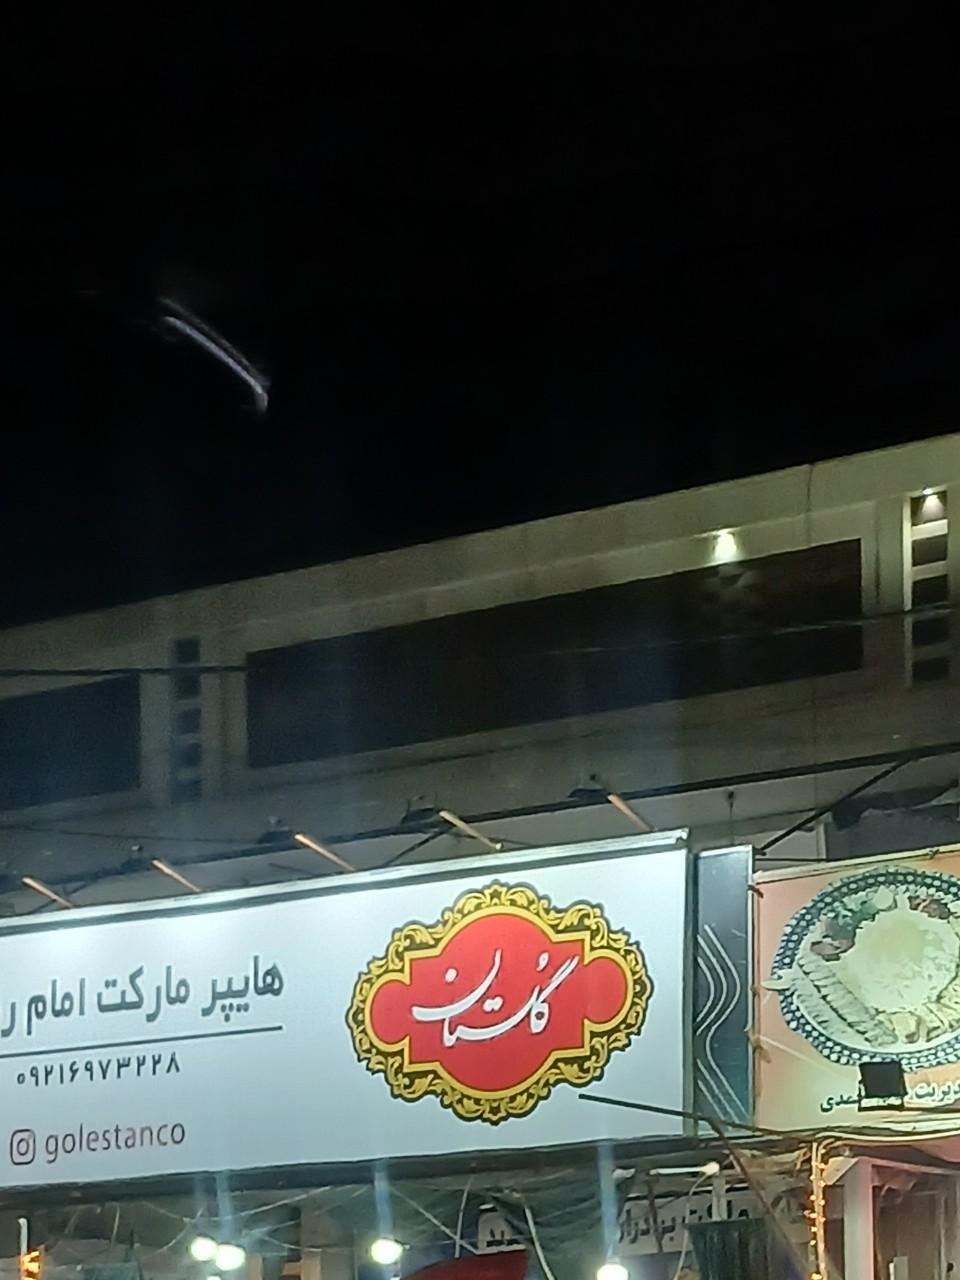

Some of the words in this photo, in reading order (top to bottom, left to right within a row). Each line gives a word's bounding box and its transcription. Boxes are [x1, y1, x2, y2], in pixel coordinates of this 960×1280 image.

[27, 977, 85, 1036] امام
[97, 965, 190, 1023] مارکت
[201, 955, 284, 1023] هایپر
[17, 1051, 180, 1087] ۰۹۲۱۶۹۷۳۲۲۸
[45, 1122, 186, 1164] golestanco
